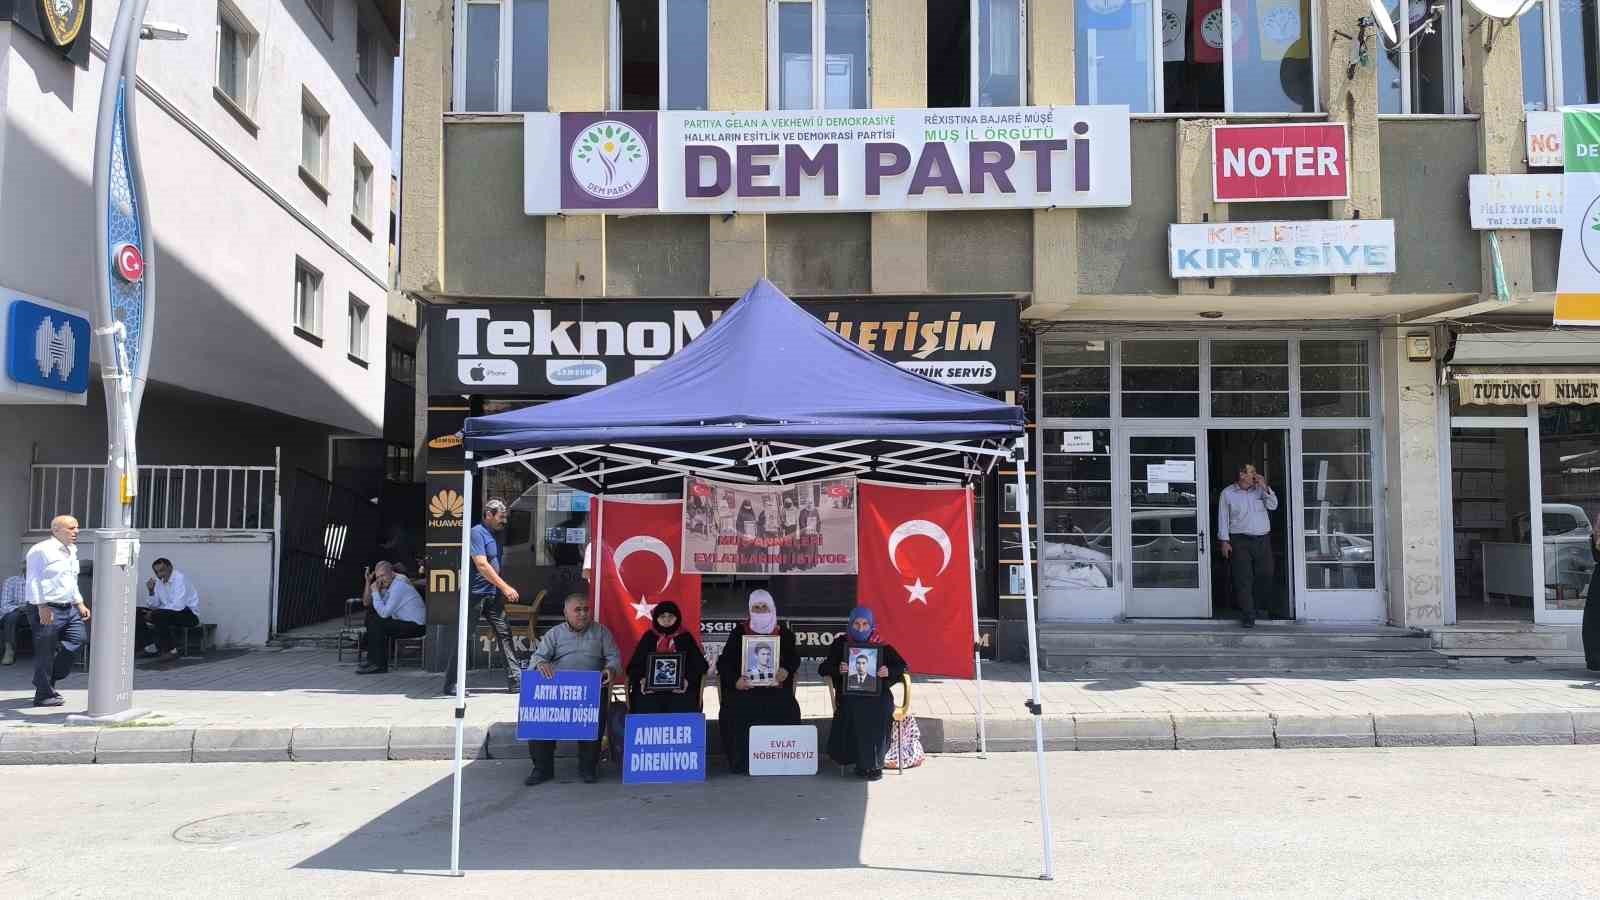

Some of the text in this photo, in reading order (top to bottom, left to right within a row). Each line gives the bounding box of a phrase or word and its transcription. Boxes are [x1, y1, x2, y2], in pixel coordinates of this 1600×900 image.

[685, 128, 896, 143] HALKLARIN EŞİTLİK VE DEMOKRASİ PARTİSİ
[924, 126, 1055, 143] MUŞ İL ÖRGÜTÜ
[1576, 143, 1600, 157] DE
[685, 121, 1091, 198] DEM PARTİ
[1222, 146, 1340, 178] NOTER
[587, 182, 607, 194] DEM
[1177, 243, 1389, 272] KIRTASİYE
[946, 364, 993, 378] SERVİS
[1474, 379, 1599, 399] TÜTÜNCÜ NİMET
[428, 520, 464, 528] HUAWE
[533, 685, 558, 700] ARTIK
[560, 685, 583, 700] YETER
[519, 703, 599, 728] YAKAMIZDAN DÜŞÜN
[634, 726, 692, 745] ANNELER
[769, 740, 797, 748] EVLAT
[631, 747, 698, 772] DİRENİYOR
